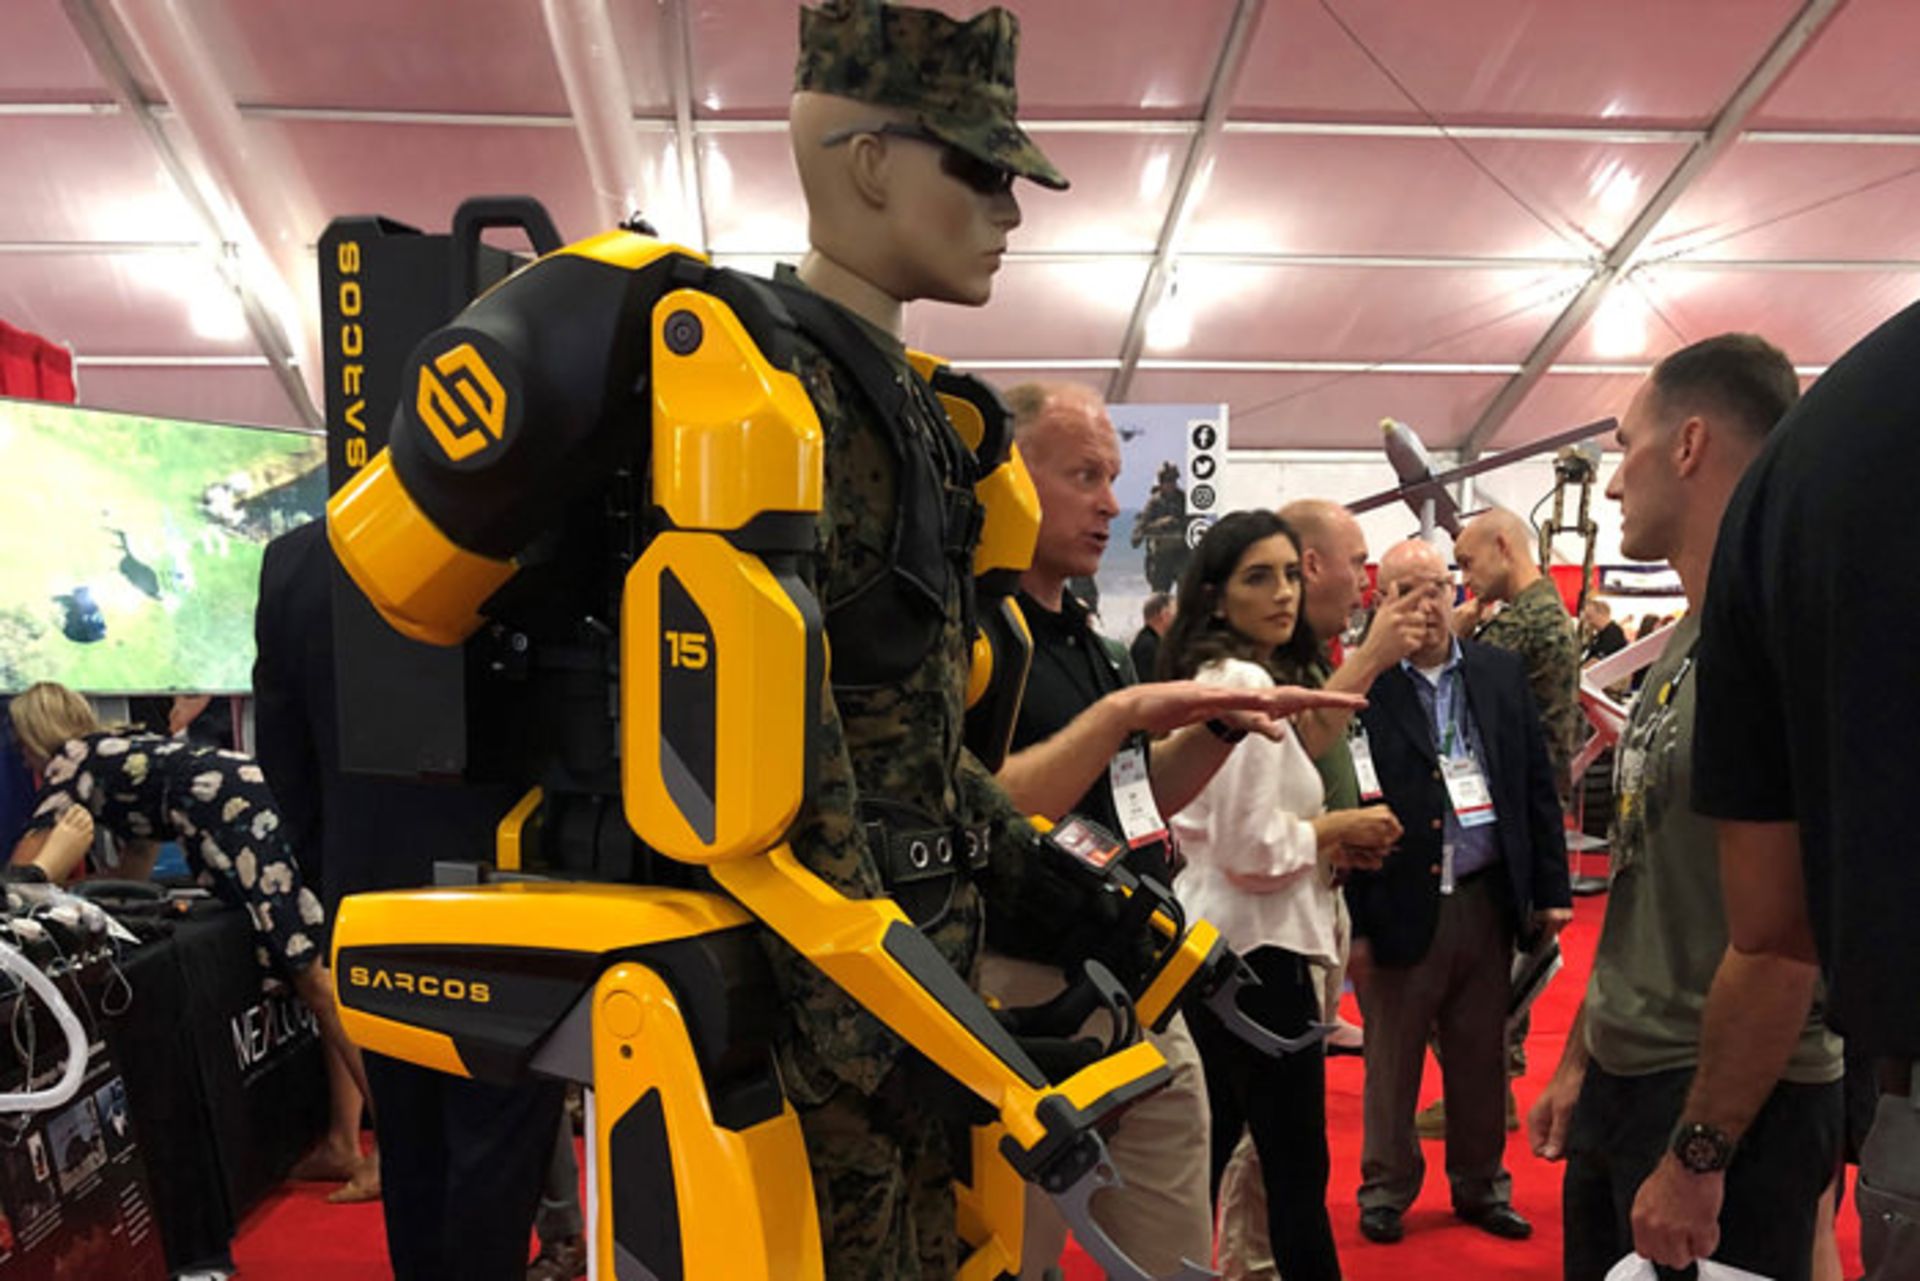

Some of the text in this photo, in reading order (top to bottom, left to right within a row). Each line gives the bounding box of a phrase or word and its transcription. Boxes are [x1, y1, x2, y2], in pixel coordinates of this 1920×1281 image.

[338, 241, 367, 468] SARCOS
[665, 631, 708, 669] 15
[350, 966, 490, 1002] SARCOS
